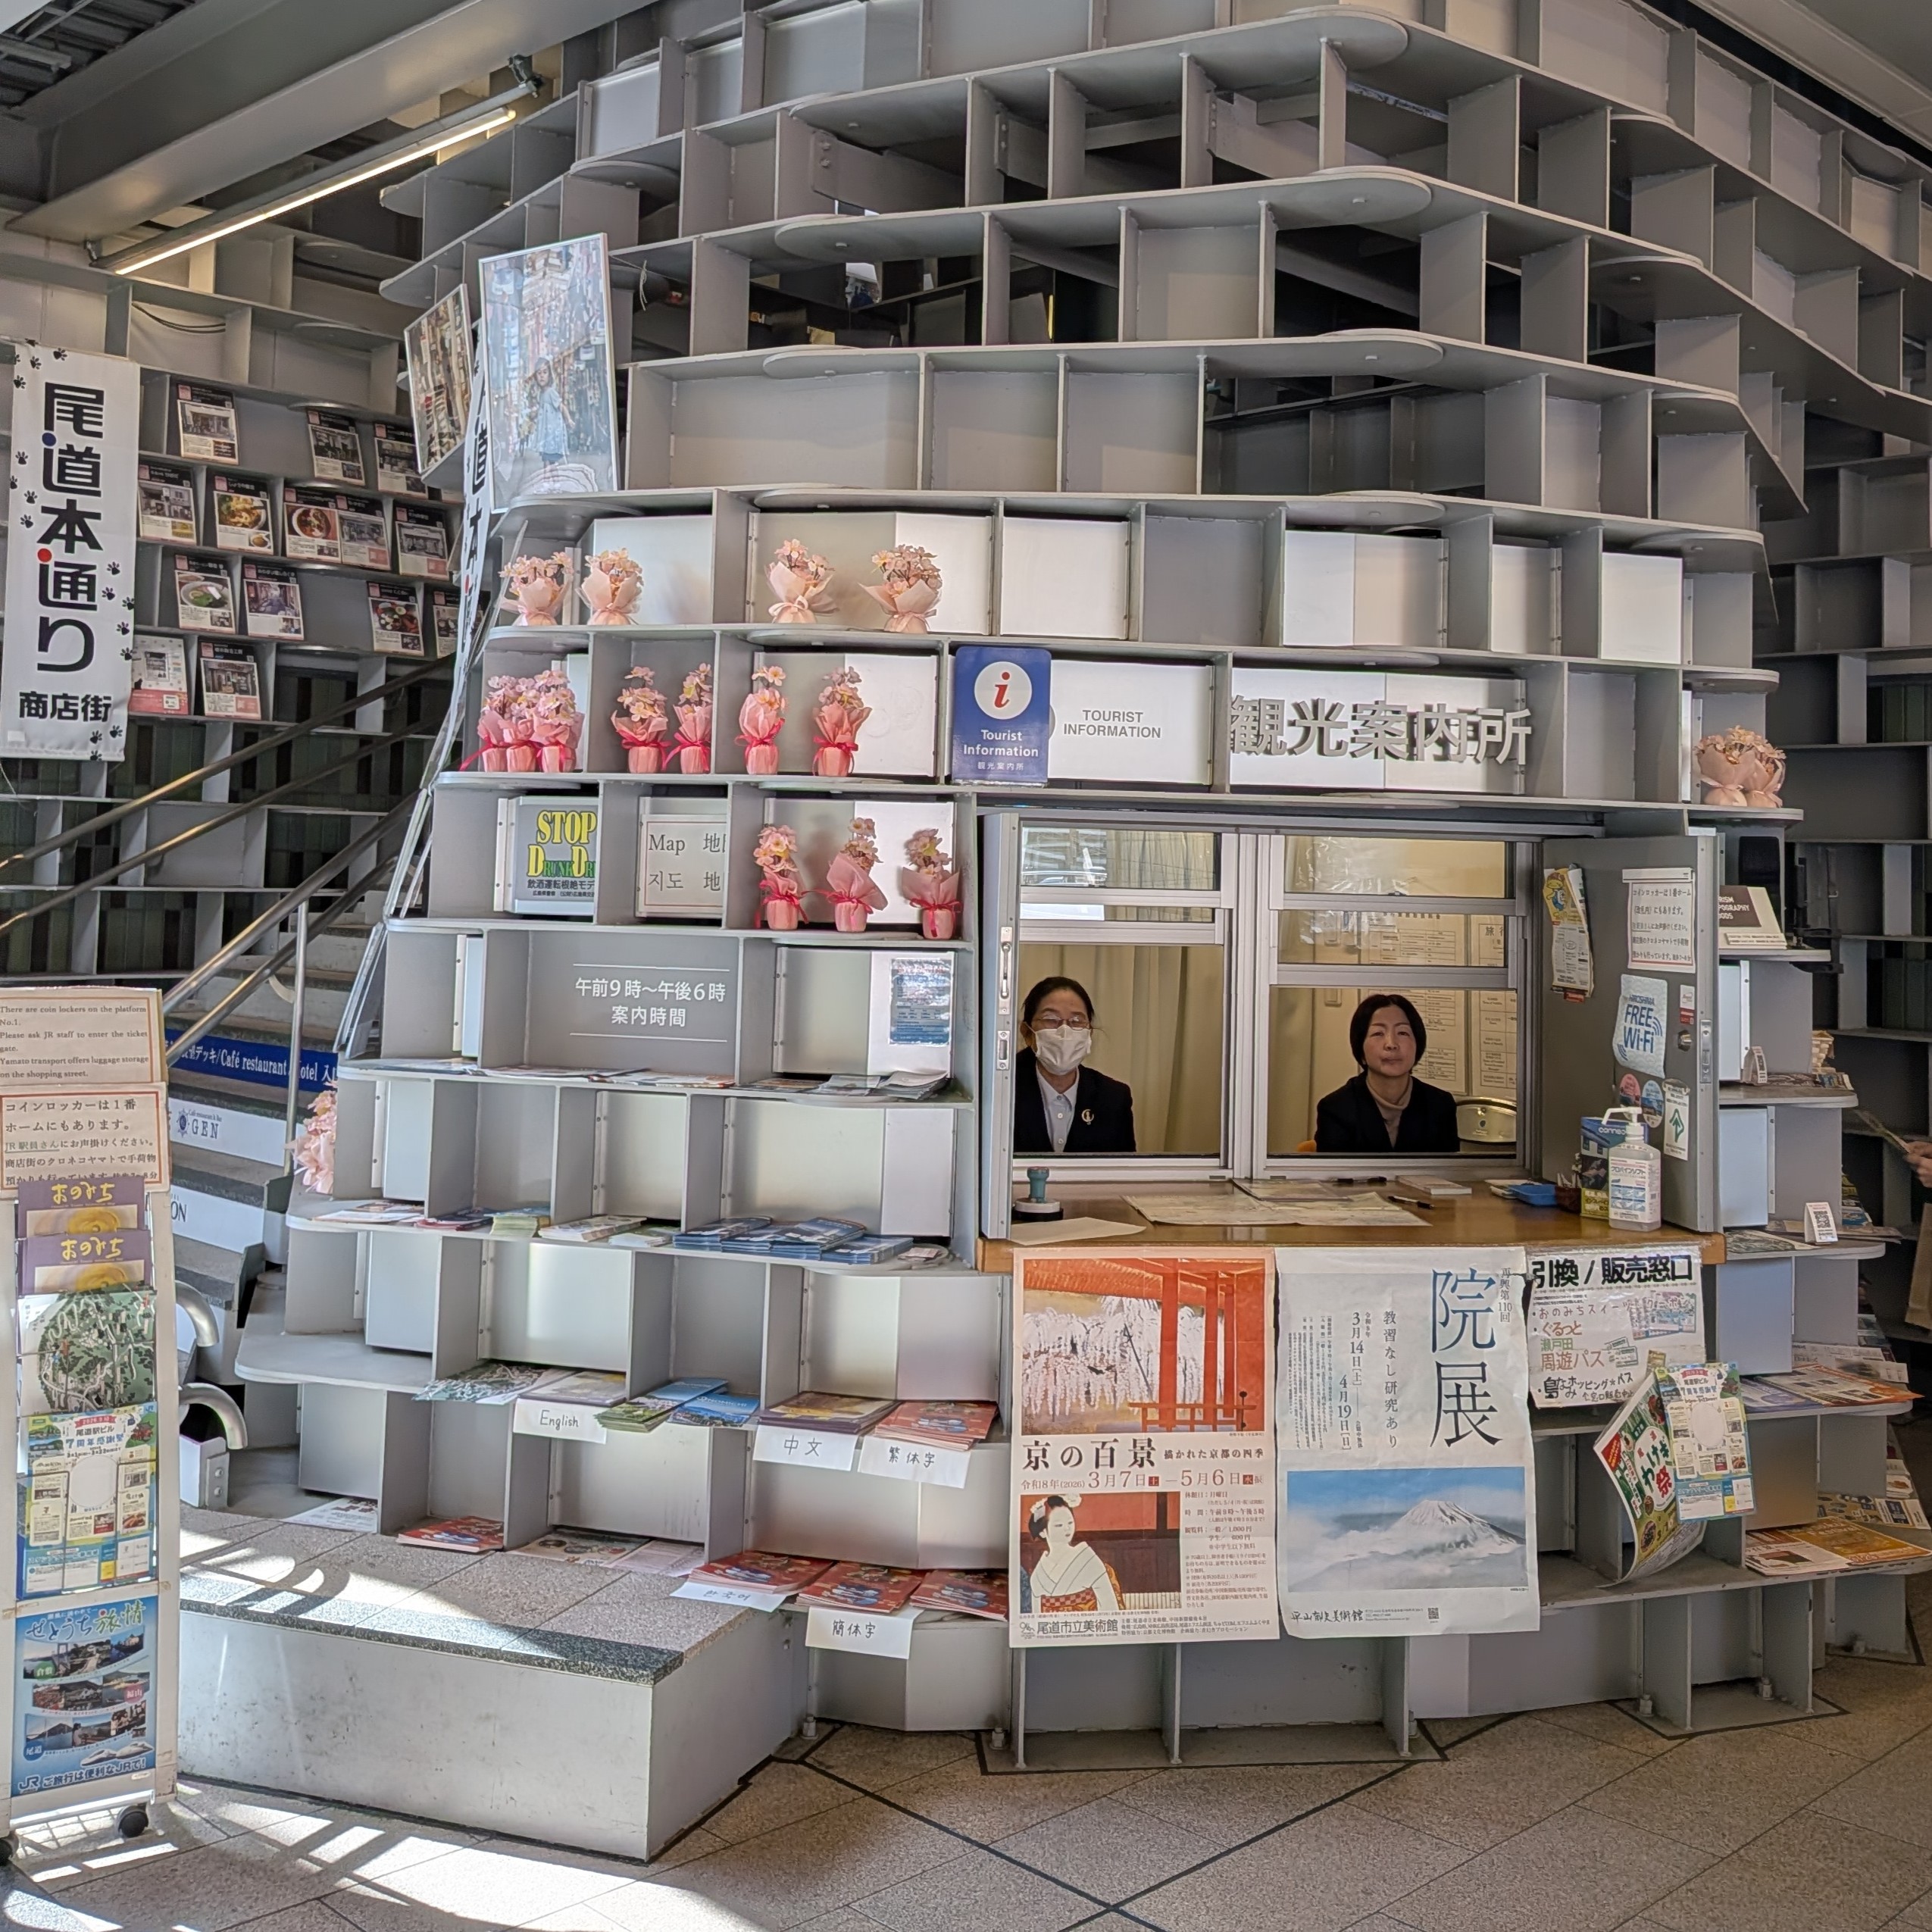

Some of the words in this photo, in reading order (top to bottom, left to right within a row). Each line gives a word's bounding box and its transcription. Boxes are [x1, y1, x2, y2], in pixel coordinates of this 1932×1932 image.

[36, 381, 105, 672] 尾道本通り
[18, 689, 112, 723] 商店街
[1083, 709, 1143, 723] TOURIST
[981, 730, 1022, 742] Tourist
[1063, 724, 1161, 738] INFORMATION
[1230, 695, 1532, 765] 観光案内所
[963, 744, 1039, 758] Information
[977, 761, 1024, 771] 観光案内所
[537, 810, 596, 843] STOP
[649, 834, 686, 855] Map
[703, 833, 726, 853] 地
[648, 871, 683, 892] 지도
[575, 977, 726, 1002] 午前9時~午後6時
[115, 1005, 146, 1014] platform
[611, 1005, 686, 1027] 案内時間
[1624, 1004, 1654, 1028] FREE
[44, 1031, 53, 1039] JR
[31, 1057, 66, 1066] transport
[91, 1056, 120, 1065] luggage
[122, 1056, 148, 1064] storage
[242, 1058, 286, 1077] restaurant
[300, 1062, 318, 1082] otel
[27, 1070, 62, 1080] shopping
[5, 1120, 130, 1133] ホームにもあります。
[192, 1118, 219, 1140] GEN
[52, 1182, 115, 1204] おのみち
[61, 1236, 124, 1261] おのみち
[1531, 1258, 1579, 1289] 引換
[1601, 1254, 1693, 1285] 販売窓口
[1543, 1321, 1583, 1336] ぐるっと
[1430, 1268, 1503, 1448] 院展
[1541, 1349, 1605, 1372] 周遊パス
[1383, 1310, 1399, 1448] 教習なし研究あり
[539, 1410, 579, 1431] English
[784, 1435, 822, 1457] 中文
[888, 1446, 936, 1468] 繁体字
[1022, 1437, 1156, 1471] 京の百景
[1164, 1448, 1264, 1459] 描かれた京都の四季
[832, 1619, 876, 1639] 簡体字
[1037, 1618, 1118, 1634] 尾道市立美術館
